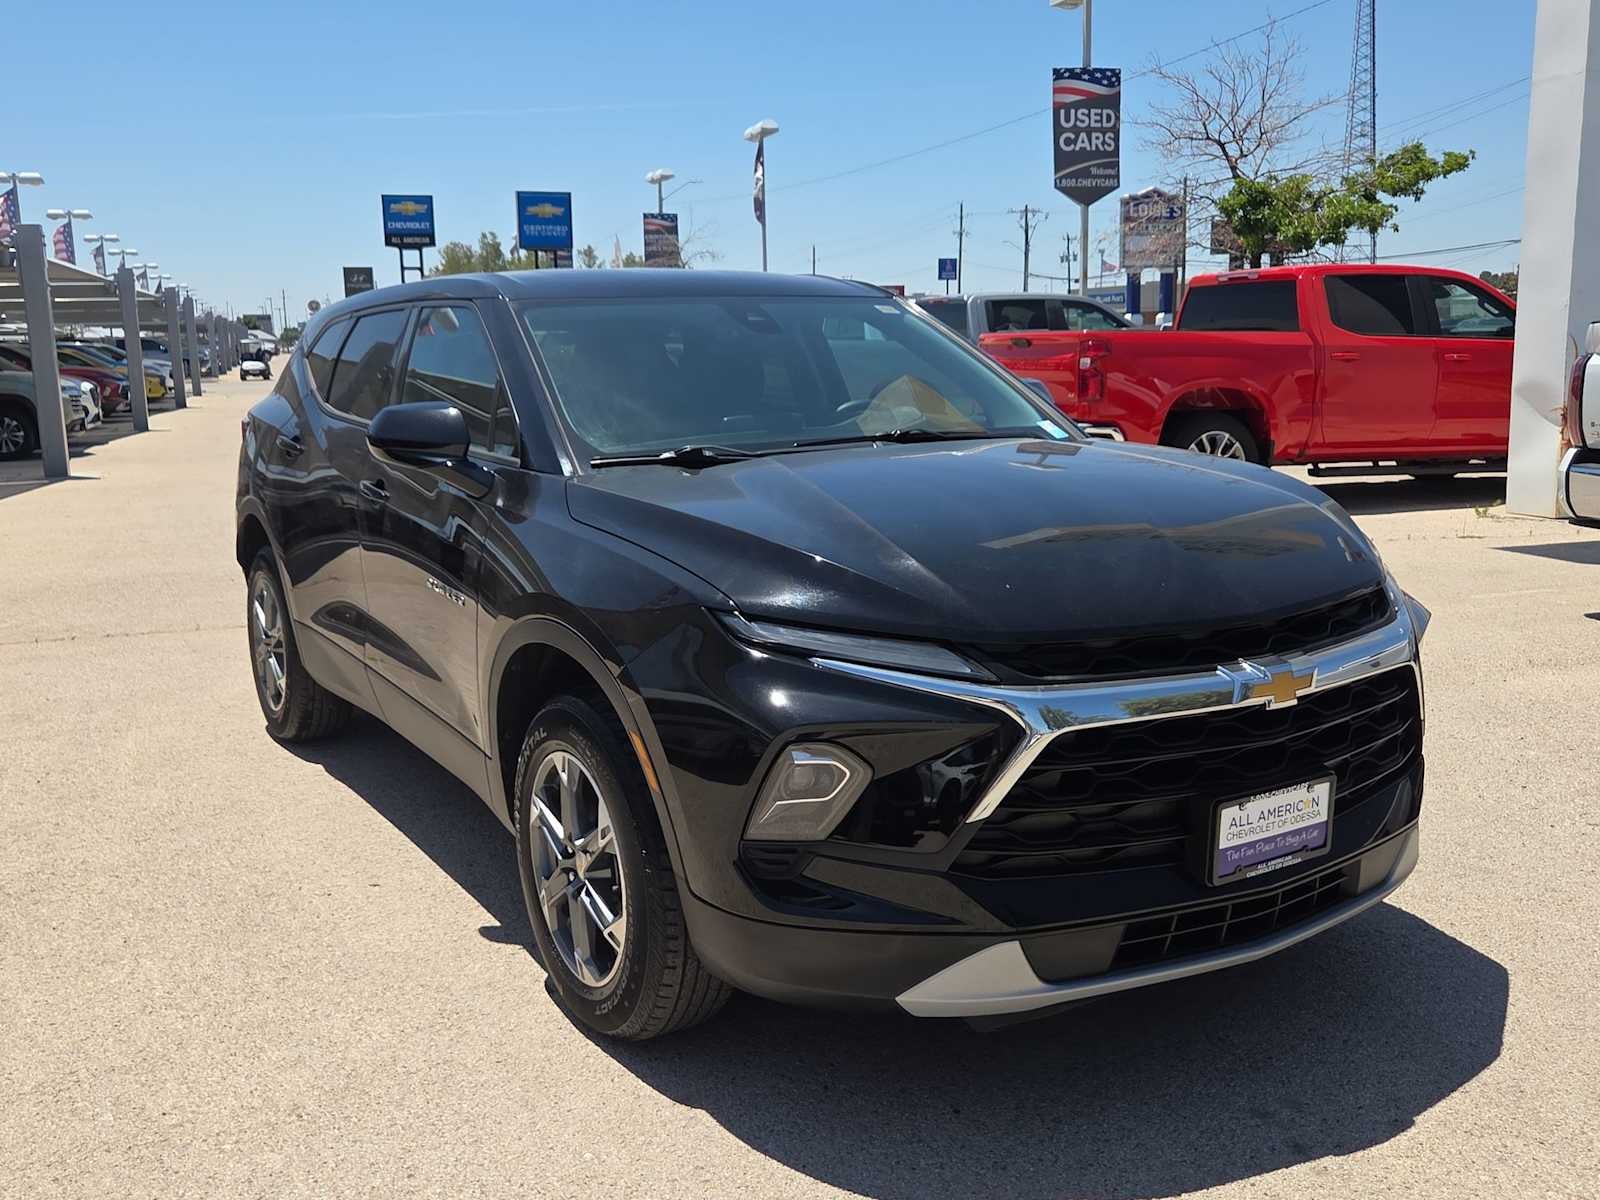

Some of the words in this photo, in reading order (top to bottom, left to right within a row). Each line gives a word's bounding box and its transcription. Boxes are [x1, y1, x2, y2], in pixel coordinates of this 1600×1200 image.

[1060, 108, 1115, 128] USED
[1059, 131, 1115, 151] CARS
[387, 221, 430, 229] CHEVROLET
[1226, 822, 1277, 842] CHEVROLET
[1277, 817, 1289, 828] OF
[1289, 809, 1321, 825] ODESSA
[1229, 814, 1253, 830] ALL
